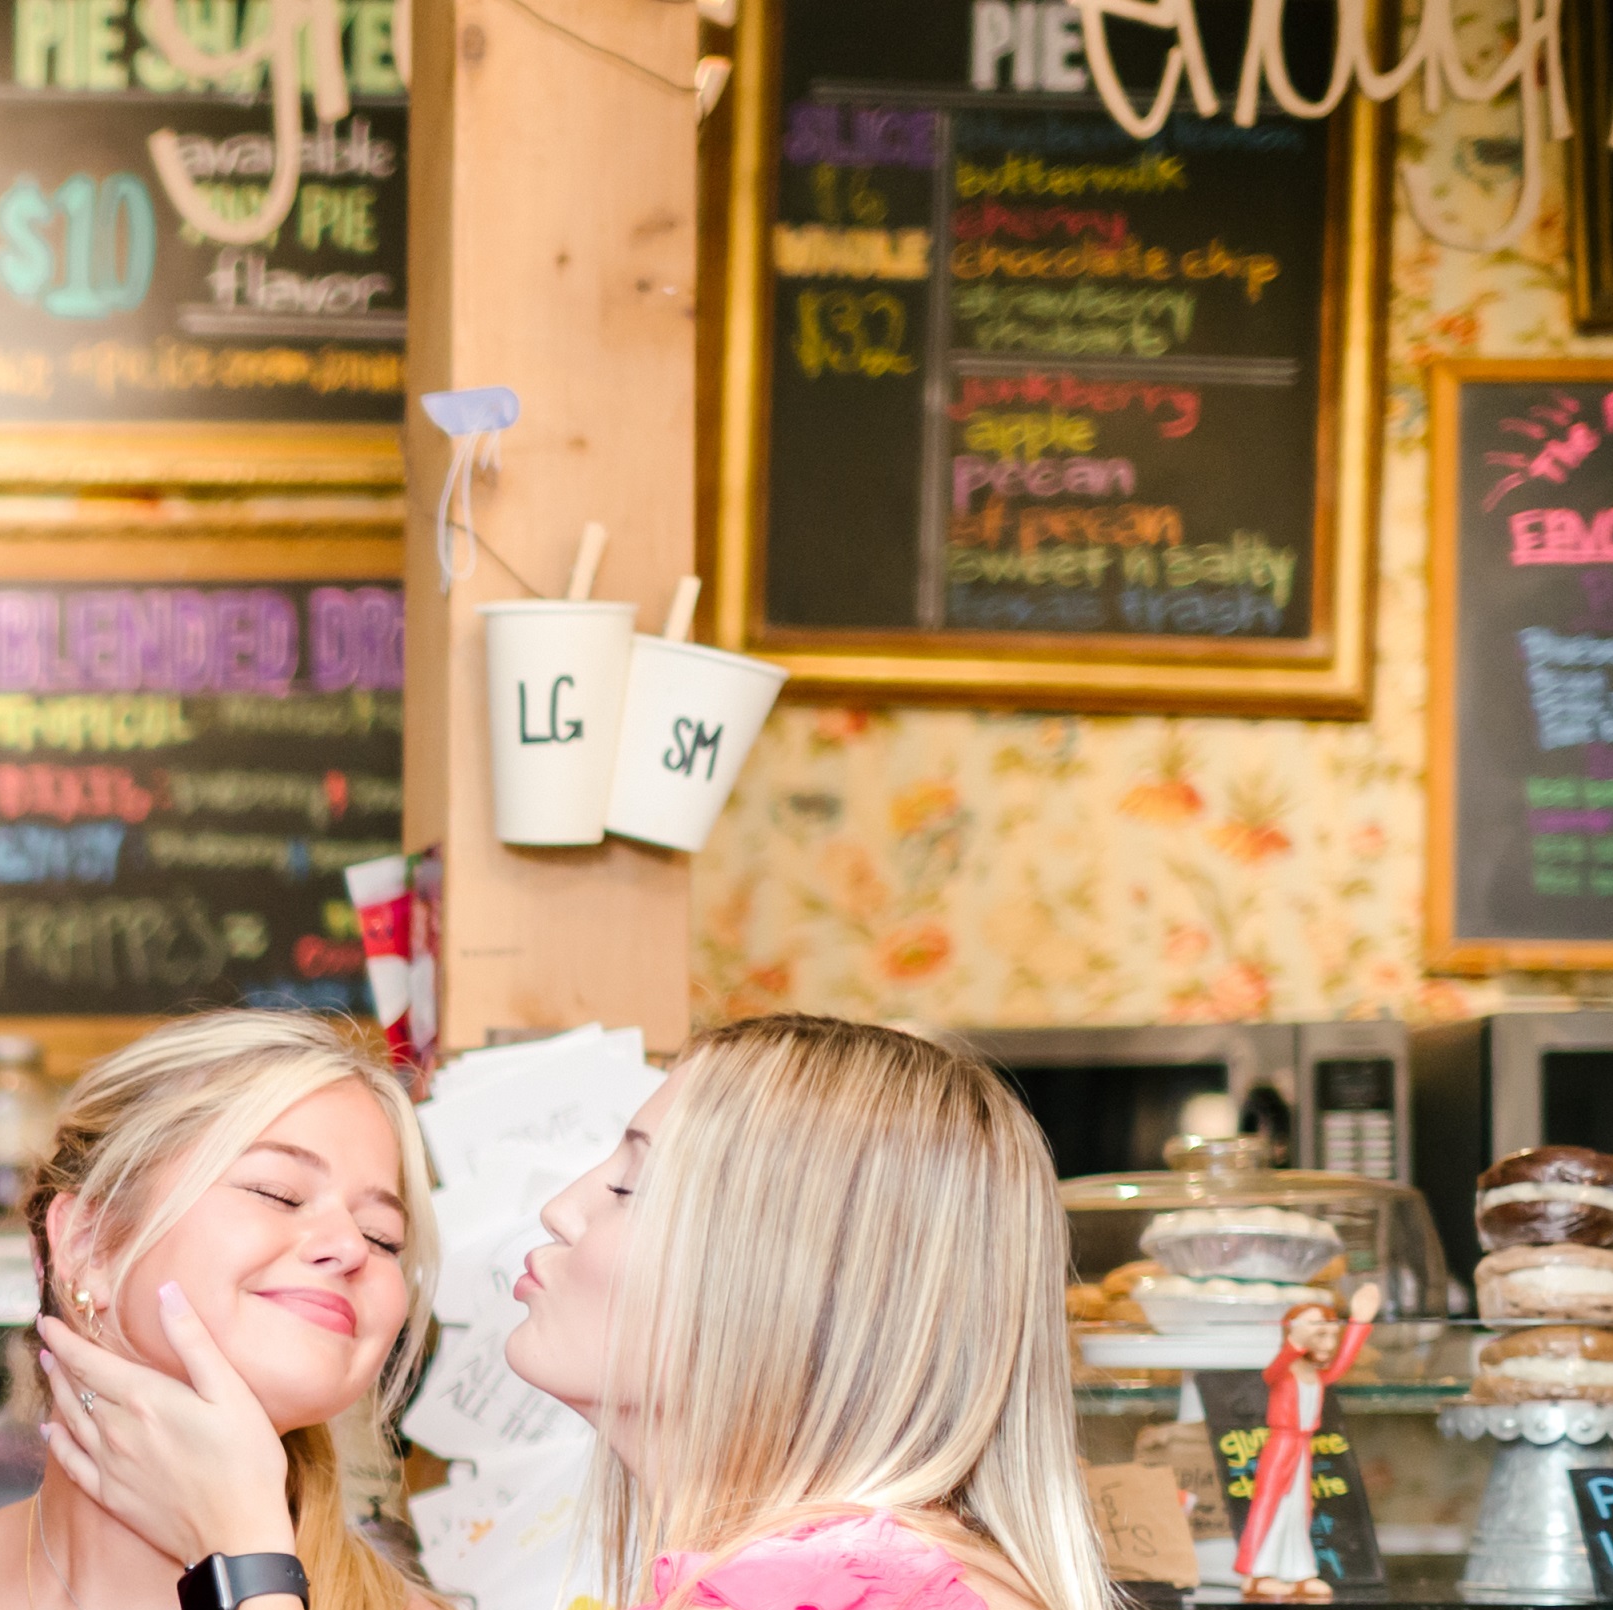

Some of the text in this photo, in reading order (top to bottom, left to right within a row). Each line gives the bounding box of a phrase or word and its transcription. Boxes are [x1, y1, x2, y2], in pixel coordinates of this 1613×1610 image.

[14, 0, 128, 91] PIE
[299, 184, 379, 252] PIE
[208, 248, 393, 313] flavor
[951, 238, 1281, 303] chocolate chip
[964, 407, 1098, 463] apple
[953, 454, 1136, 516] pecan
[1018, 504, 1184, 558] pecan
[947, 541, 1114, 588] sweet
[1164, 530, 1297, 609] salty
[517, 675, 584, 745] LG
[662, 717, 724, 781] SM
